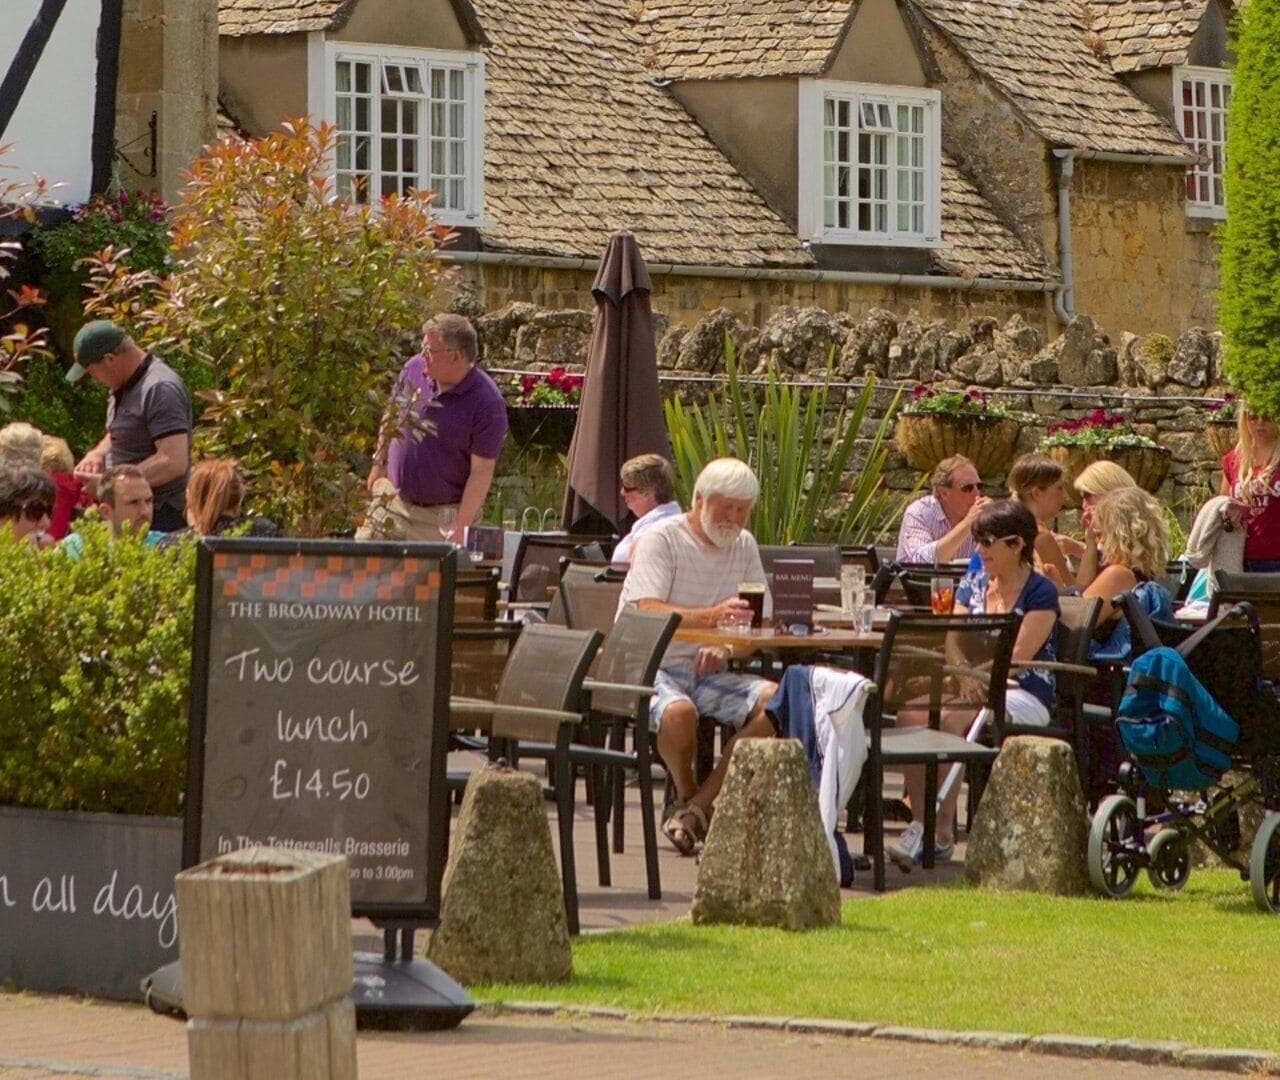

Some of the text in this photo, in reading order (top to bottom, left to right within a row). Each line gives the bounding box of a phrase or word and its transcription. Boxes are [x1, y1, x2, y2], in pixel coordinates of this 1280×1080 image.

[228, 602, 422, 621] THE BROADWAY HOTEL
[224, 647, 419, 686] Two course
[276, 709, 368, 742] lunch
[270, 759, 370, 800] £14.50
[218, 835, 232, 854] In
[345, 836, 410, 857] Brasserie
[362, 866, 374, 880] to
[375, 865, 414, 882] 3.00pm
[32, 875, 77, 913] all
[93, 869, 179, 949] day
